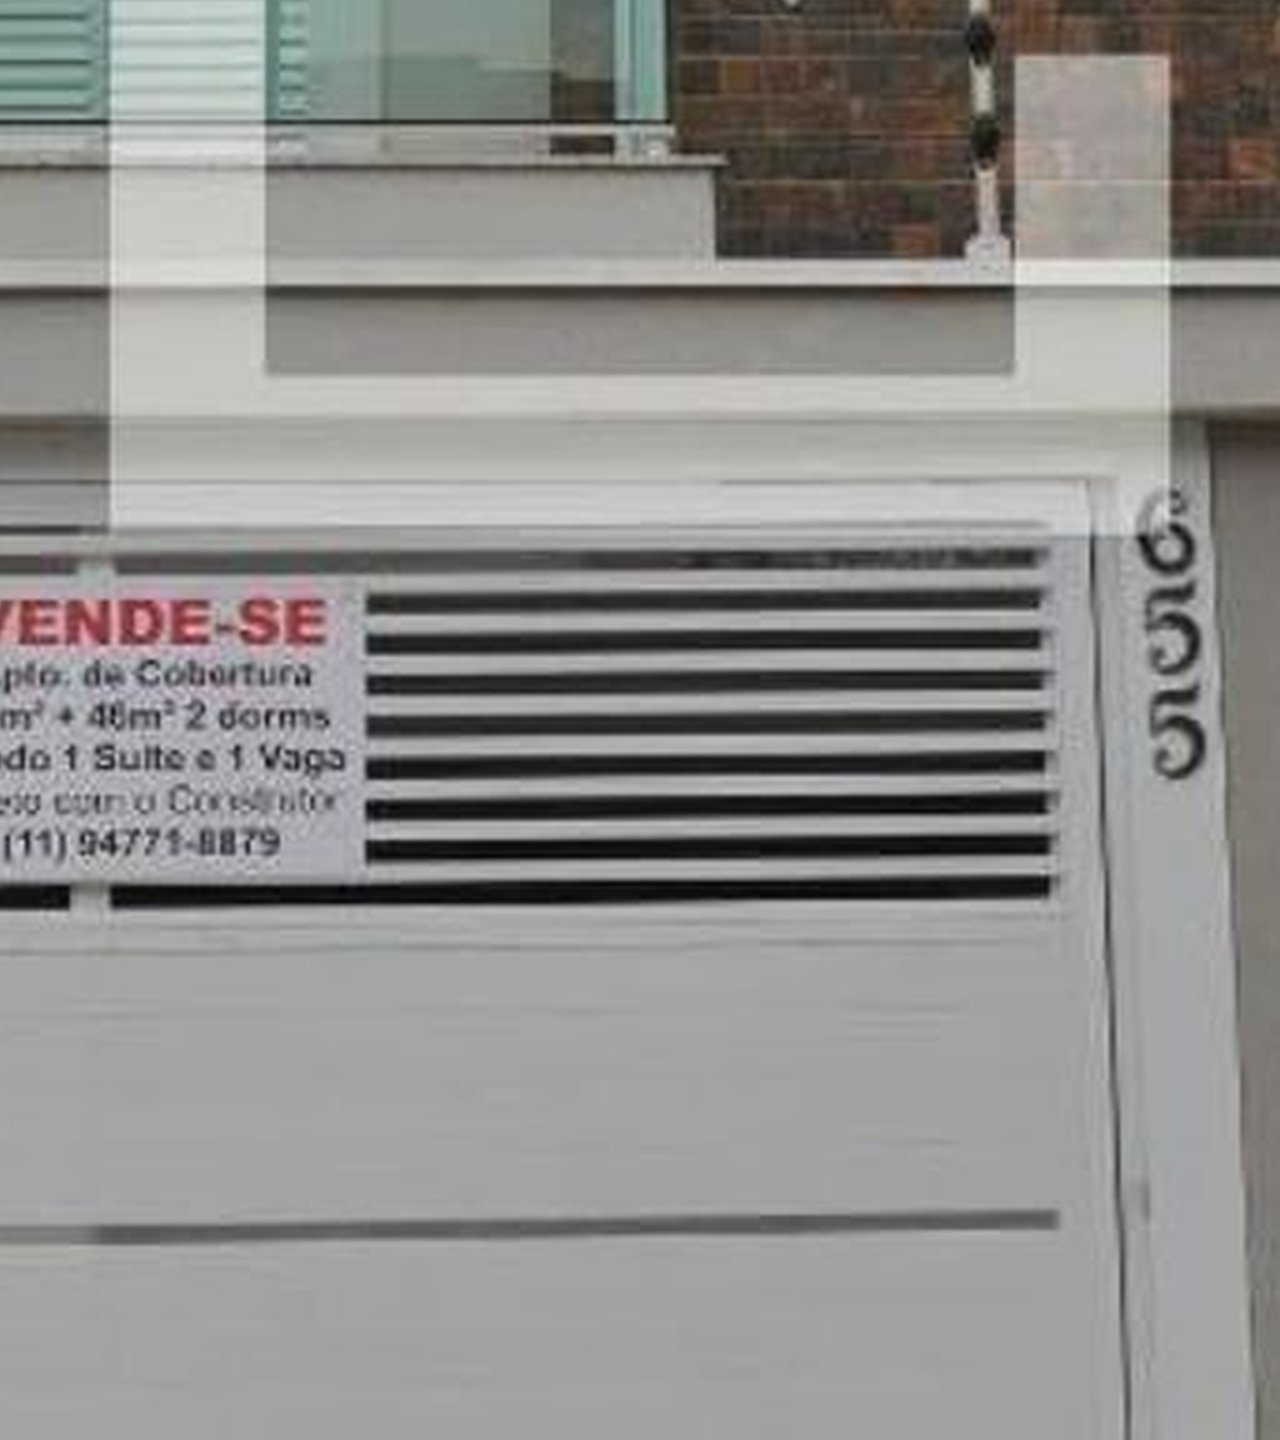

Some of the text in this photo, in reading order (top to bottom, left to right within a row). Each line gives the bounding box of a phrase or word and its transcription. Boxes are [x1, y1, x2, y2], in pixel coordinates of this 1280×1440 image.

[1135, 482, 1207, 781] 655
[83, 660, 121, 688] de
[135, 659, 313, 688] Cobertura
[185, 700, 206, 731] 2
[219, 700, 332, 731] dorms
[64, 745, 79, 771] 1
[196, 750, 216, 772] e
[230, 744, 244, 771] 1
[259, 744, 347, 778] Vaga
[3, 829, 67, 864] (11)
